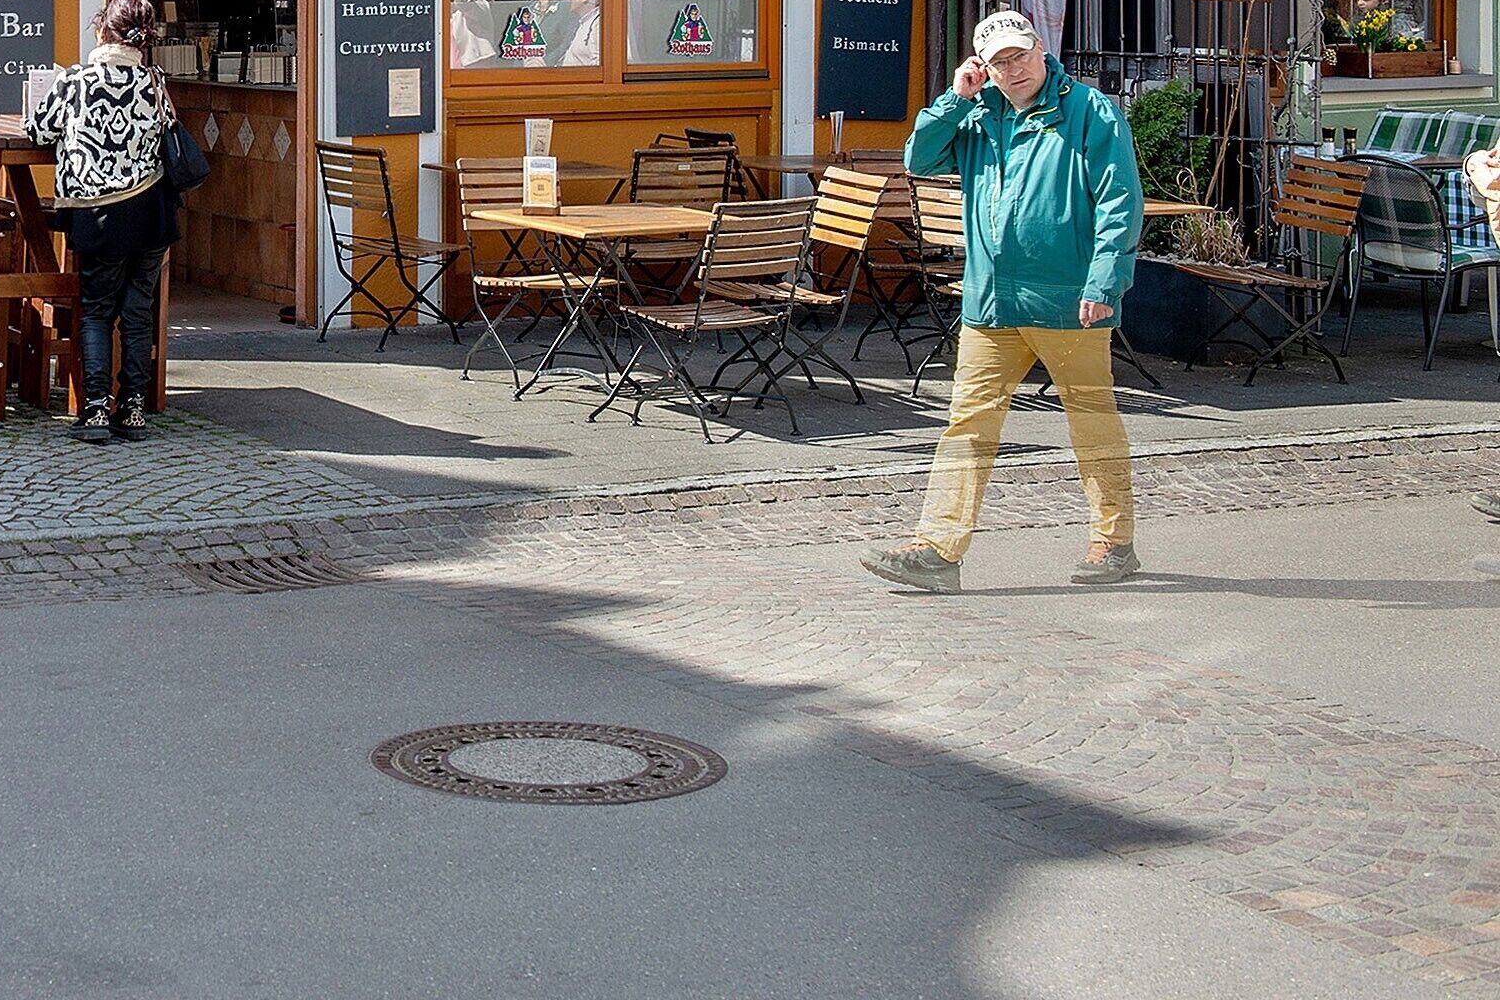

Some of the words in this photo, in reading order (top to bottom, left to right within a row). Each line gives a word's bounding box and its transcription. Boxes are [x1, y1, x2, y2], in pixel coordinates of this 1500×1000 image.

[341, 2, 431, 18] Hamburger
[0, 12, 45, 38] Bar
[339, 40, 432, 57] Currywurst
[504, 45, 545, 59] Rothaus
[671, 41, 712, 55] Rothaus
[832, 36, 900, 52] Bismarck
